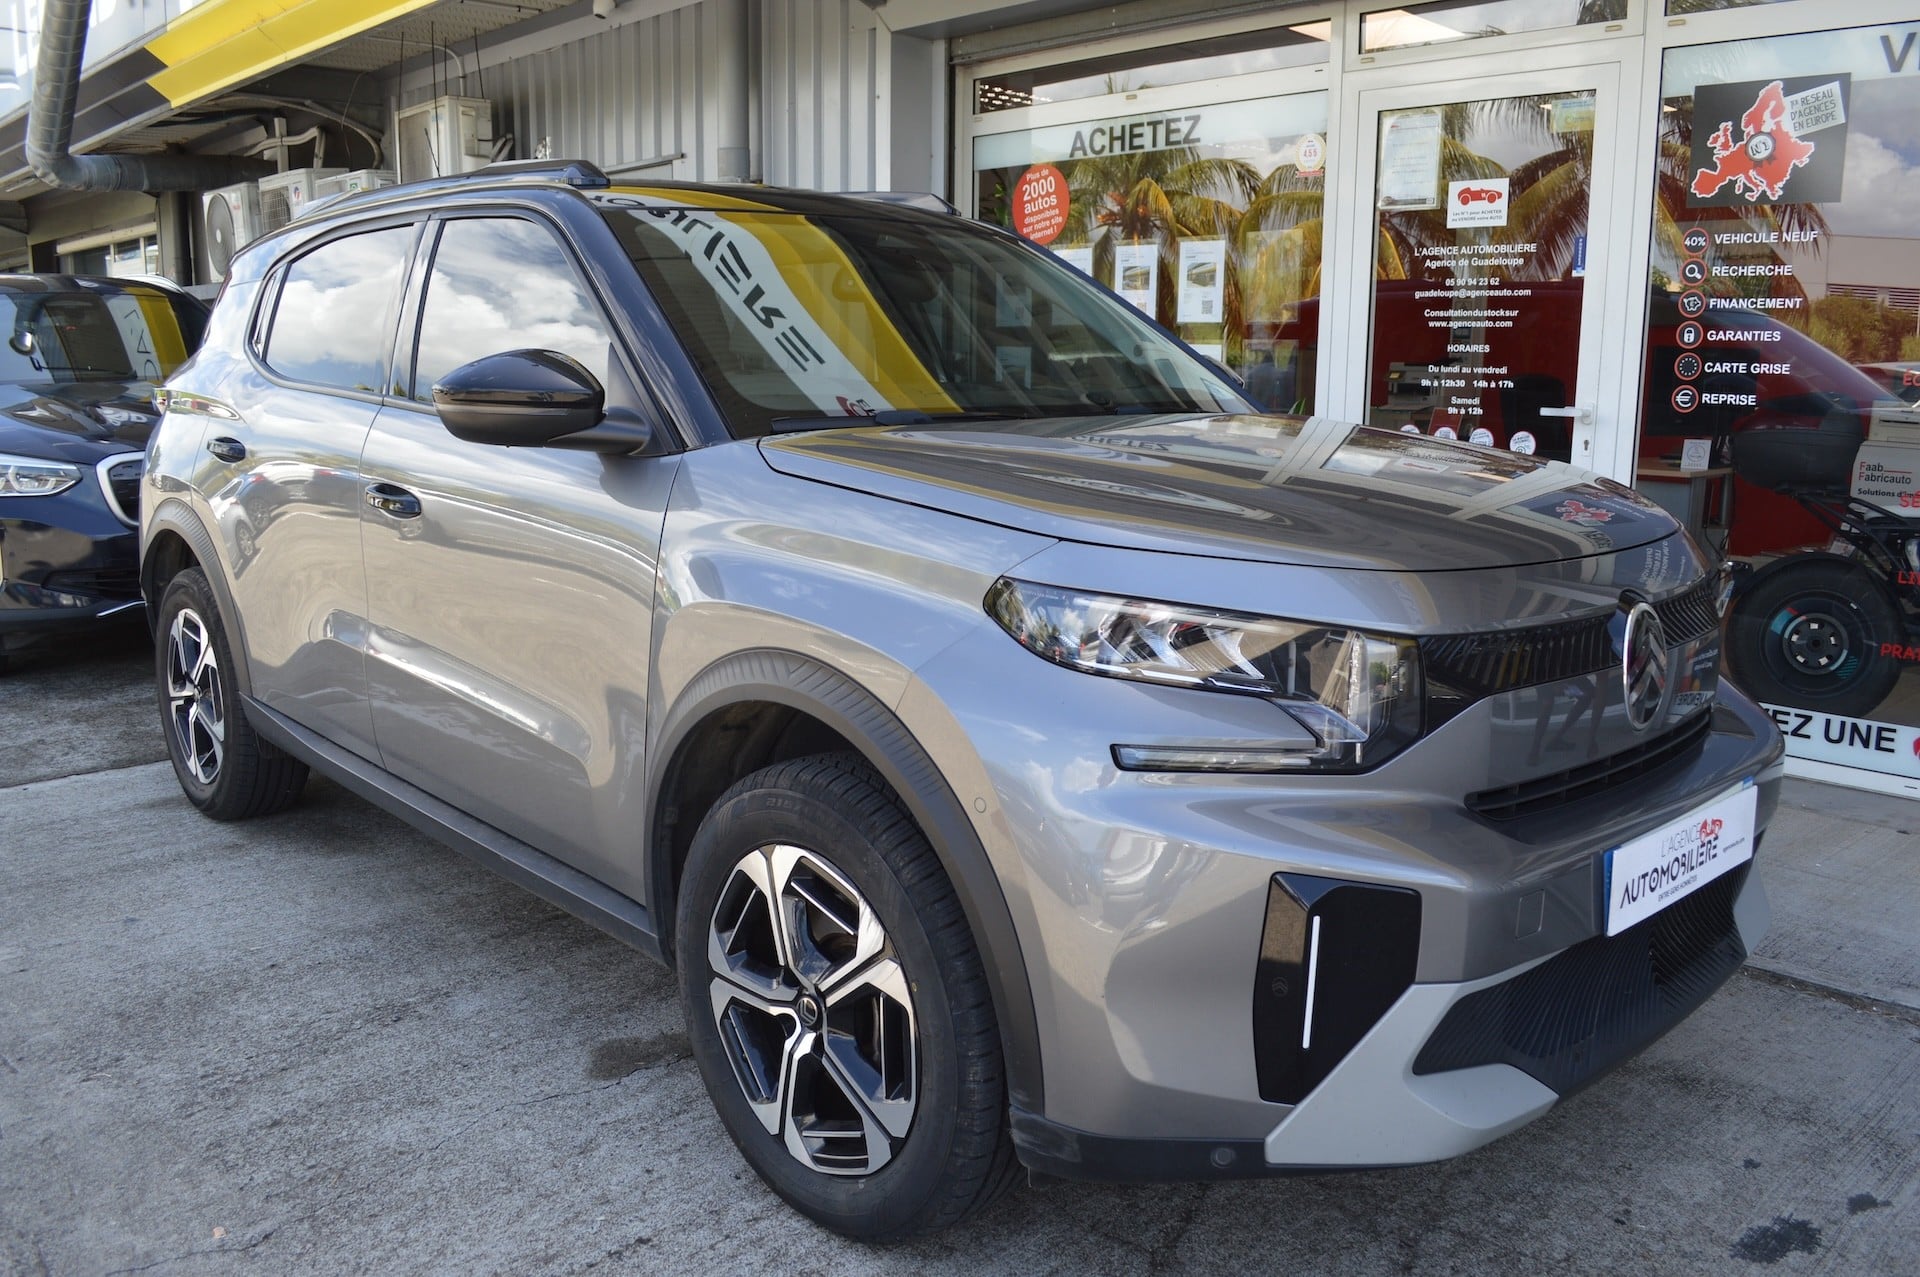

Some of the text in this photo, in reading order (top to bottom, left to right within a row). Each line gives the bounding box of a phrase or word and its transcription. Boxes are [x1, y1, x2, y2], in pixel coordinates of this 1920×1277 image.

[1879, 31, 1920, 73] V
[1800, 88, 1834, 106] RESEAU
[1790, 99, 1837, 121] D'AGENCES
[1793, 111, 1838, 131] EN EUROPE
[1069, 114, 1201, 158] ACHETEZ
[1026, 169, 1049, 181] Plus de
[1022, 175, 1056, 202] 2000
[1024, 194, 1058, 214] autos
[1024, 208, 1059, 225] disponibles
[1023, 216, 1063, 234] sur notre site
[1714, 230, 1818, 245] VEHICULE NEUF
[1414, 243, 1537, 257] L'AGENCE AUTOMOBILIERE
[1424, 257, 1525, 269] Agence de Guadeloupe
[1712, 264, 1792, 277] RECHERCHE
[1445, 278, 1456, 287] 05
[1467, 278, 1477, 286] 94
[1479, 278, 1488, 286] 23
[1490, 277, 1500, 285] 62
[1414, 288, 1532, 299] guadeloupe@agenceauto.com
[1709, 297, 1803, 309] FINANCEMENT
[1424, 309, 1473, 317] Consultation
[1428, 320, 1513, 329] www.agenceauto.com
[1707, 330, 1781, 342] GARANTIES
[1447, 344, 1491, 353] HORAIRES
[1428, 365, 1439, 373] Du
[1440, 365, 1460, 373] lundi
[1473, 366, 1508, 375] vendredi
[1704, 362, 1791, 375] CARTE GRISE
[1421, 379, 1514, 389] 9h à 12h30 14h à 17h
[1451, 396, 1480, 405] Samedi
[1702, 393, 1757, 406] REPRISE
[1447, 406, 1483, 415] 9h à 12h
[1859, 461, 1884, 472] Faab
[1858, 472, 1912, 485] Fabricauto
[1857, 487, 1896, 497] Solutions
[1824, 718, 1897, 753] UNE
[1661, 822, 1701, 858] L'AGENCE
